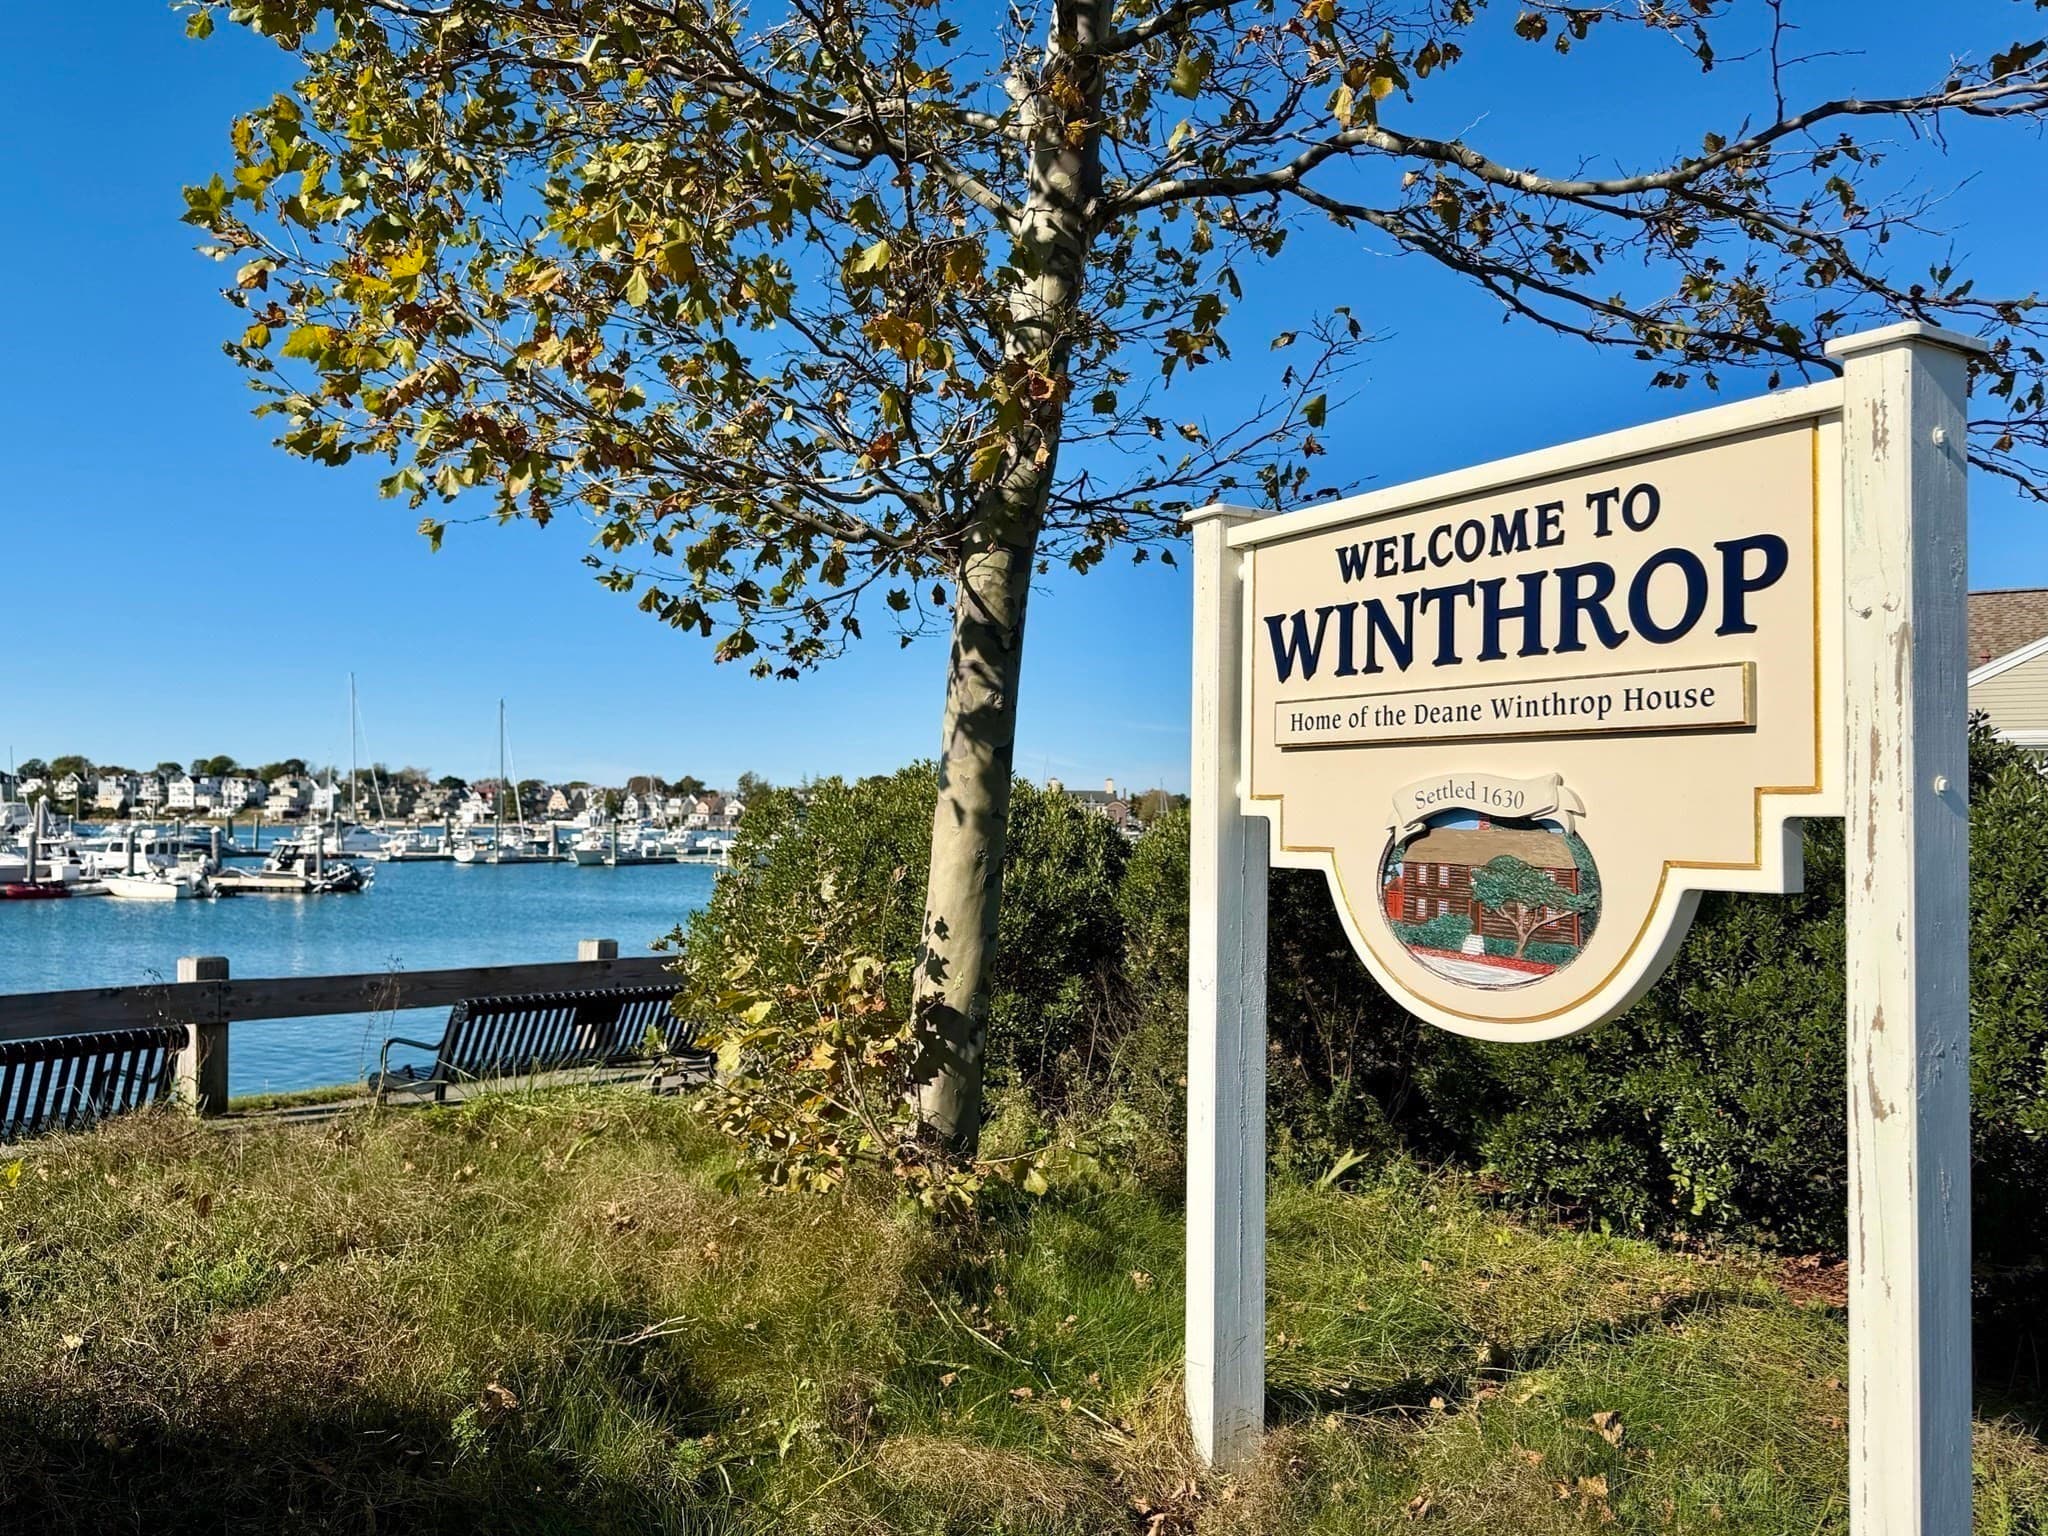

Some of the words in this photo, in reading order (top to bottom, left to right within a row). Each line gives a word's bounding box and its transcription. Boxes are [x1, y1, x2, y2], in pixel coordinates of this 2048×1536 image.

[1335, 500, 1566, 584] WELCOME
[1586, 483, 1661, 538] TO
[1264, 533, 1789, 684] WINTHROP
[1290, 712, 1342, 732] Home
[1348, 705, 1369, 729] of
[1374, 704, 1407, 727] the
[1414, 703, 1483, 726] Deane
[1490, 691, 1613, 722] Winthrop
[1623, 684, 1716, 713] House
[1415, 779, 1476, 810] Settled
[1481, 786, 1525, 810] 1630
